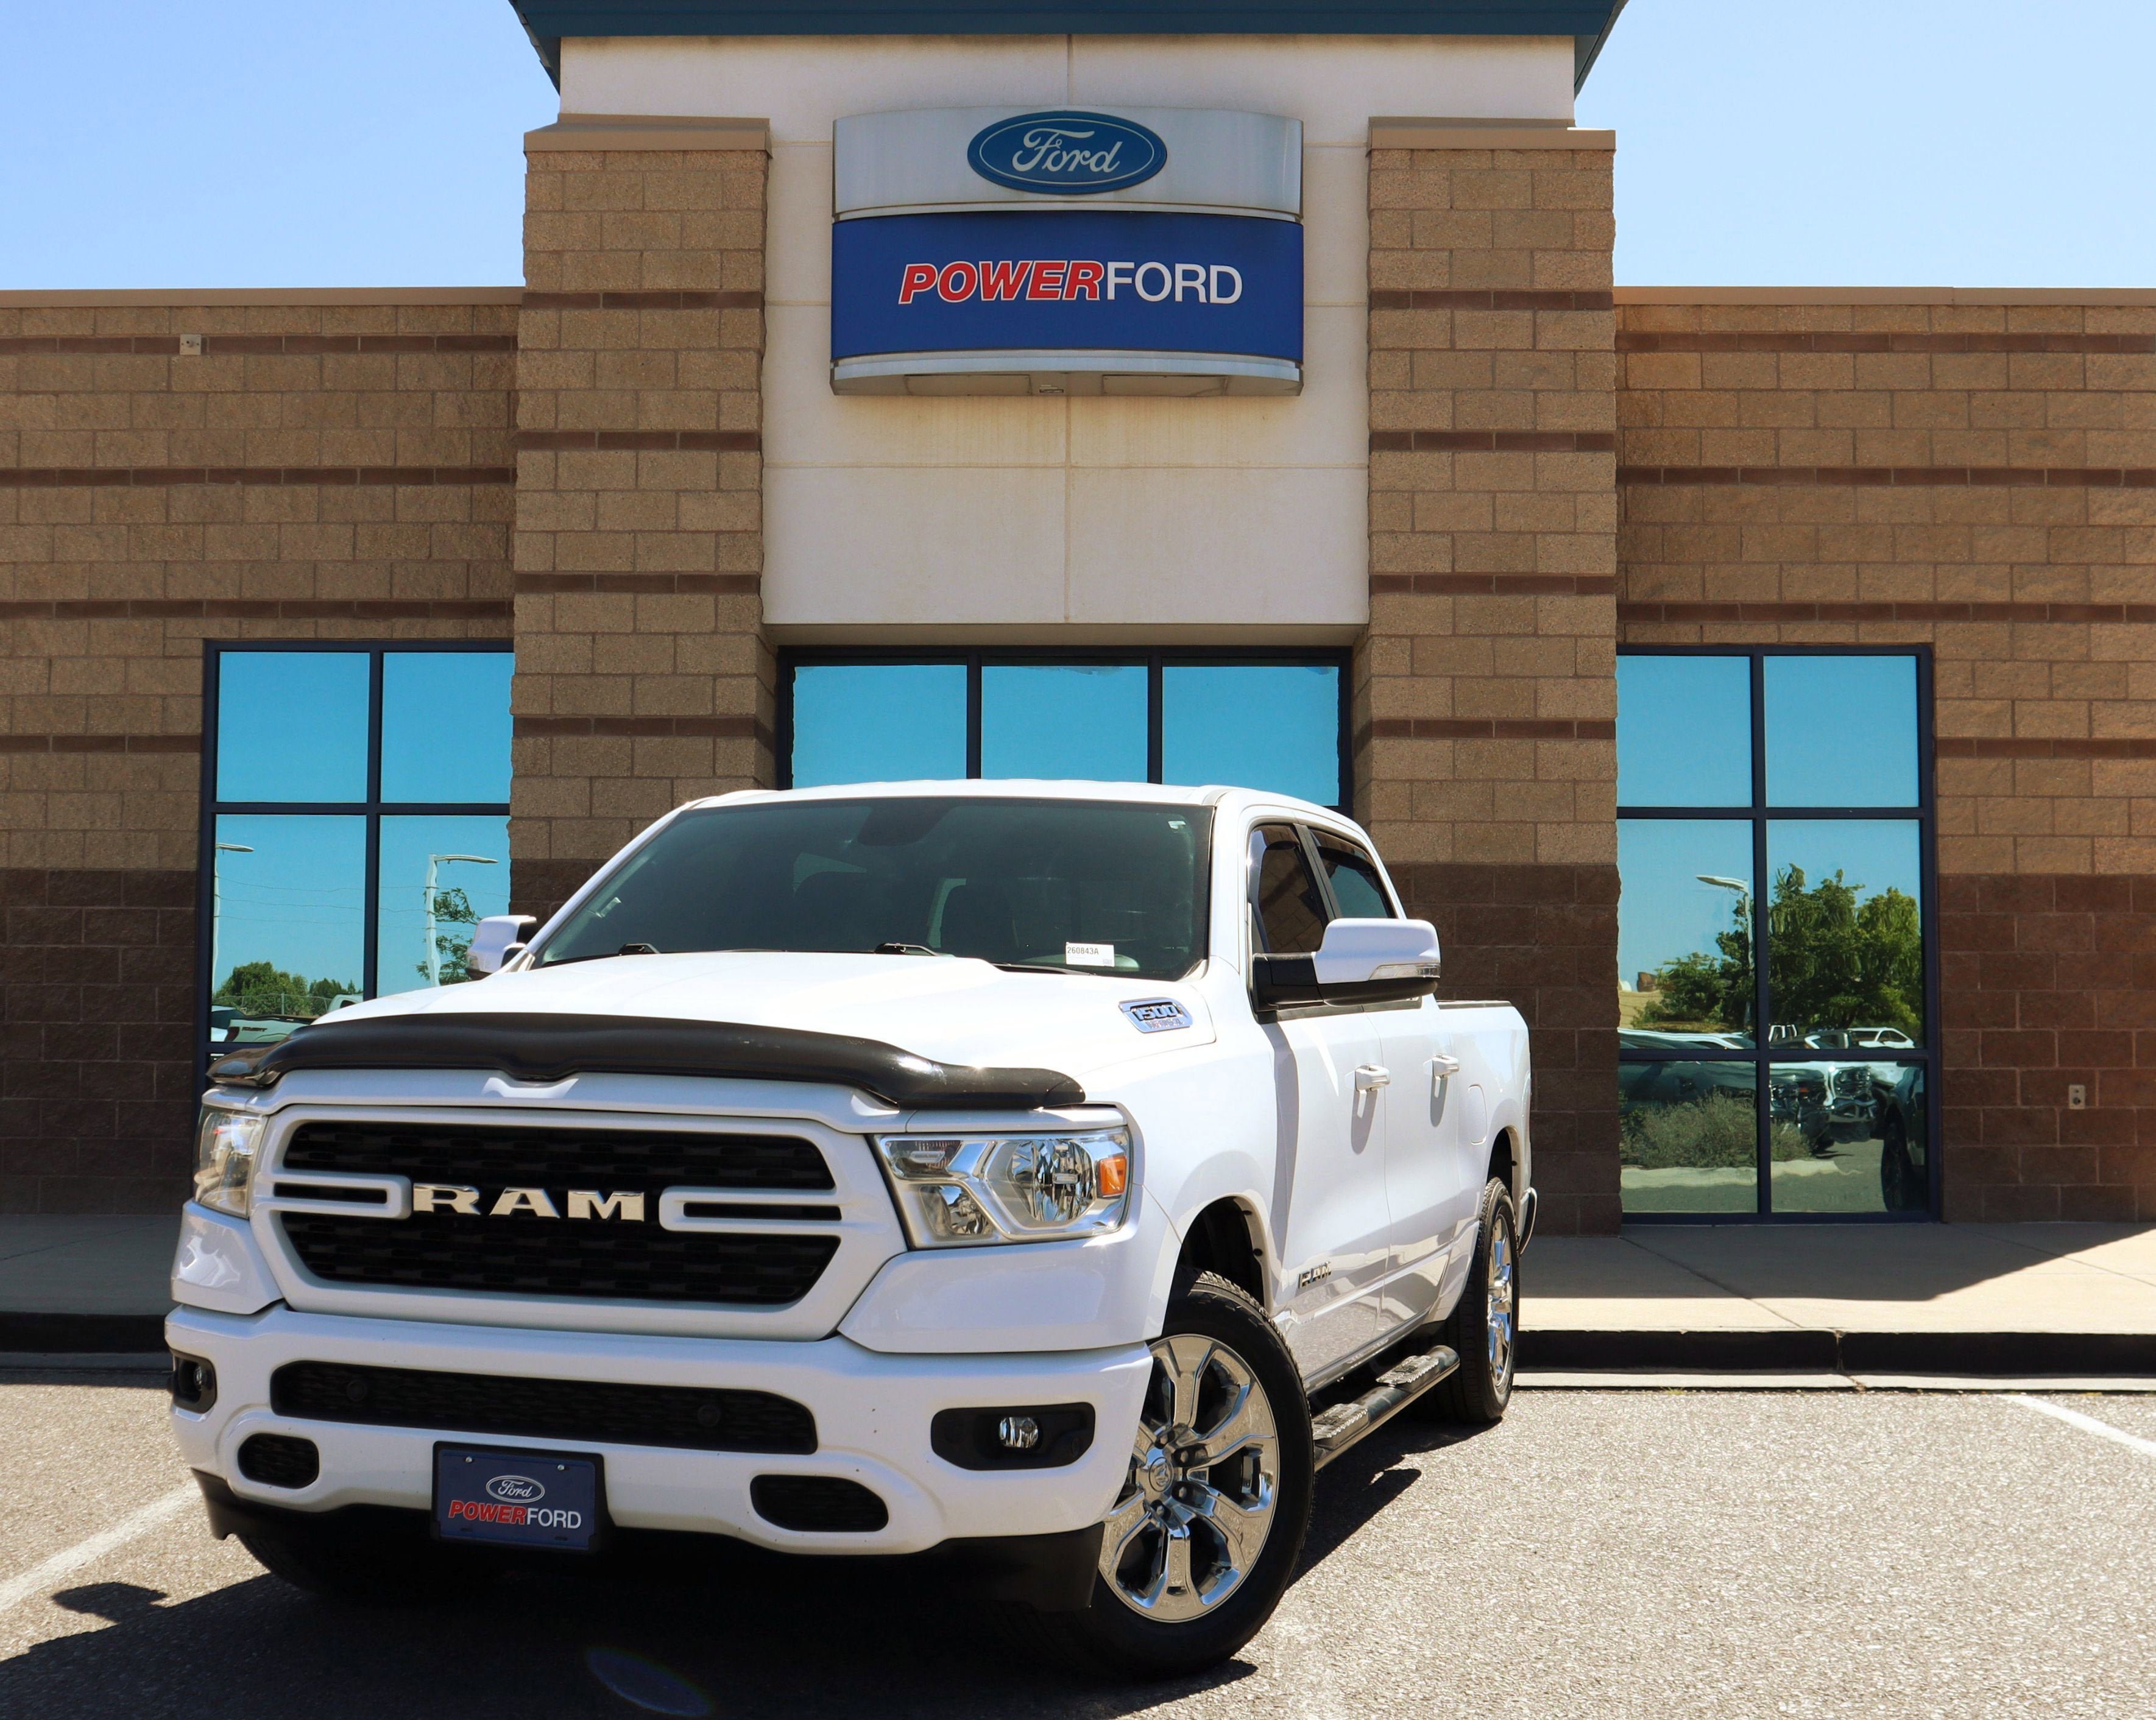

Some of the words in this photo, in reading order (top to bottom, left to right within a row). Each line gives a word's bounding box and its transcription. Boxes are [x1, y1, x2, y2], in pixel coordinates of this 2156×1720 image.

[1011, 127, 1123, 173] Ford
[1067, 946, 1099, 955] 260843A
[1130, 1003, 1181, 1021] 1500
[413, 1183, 645, 1222] RAM
[1298, 1261, 1332, 1289] RAM
[498, 1479, 533, 1498] Ford
